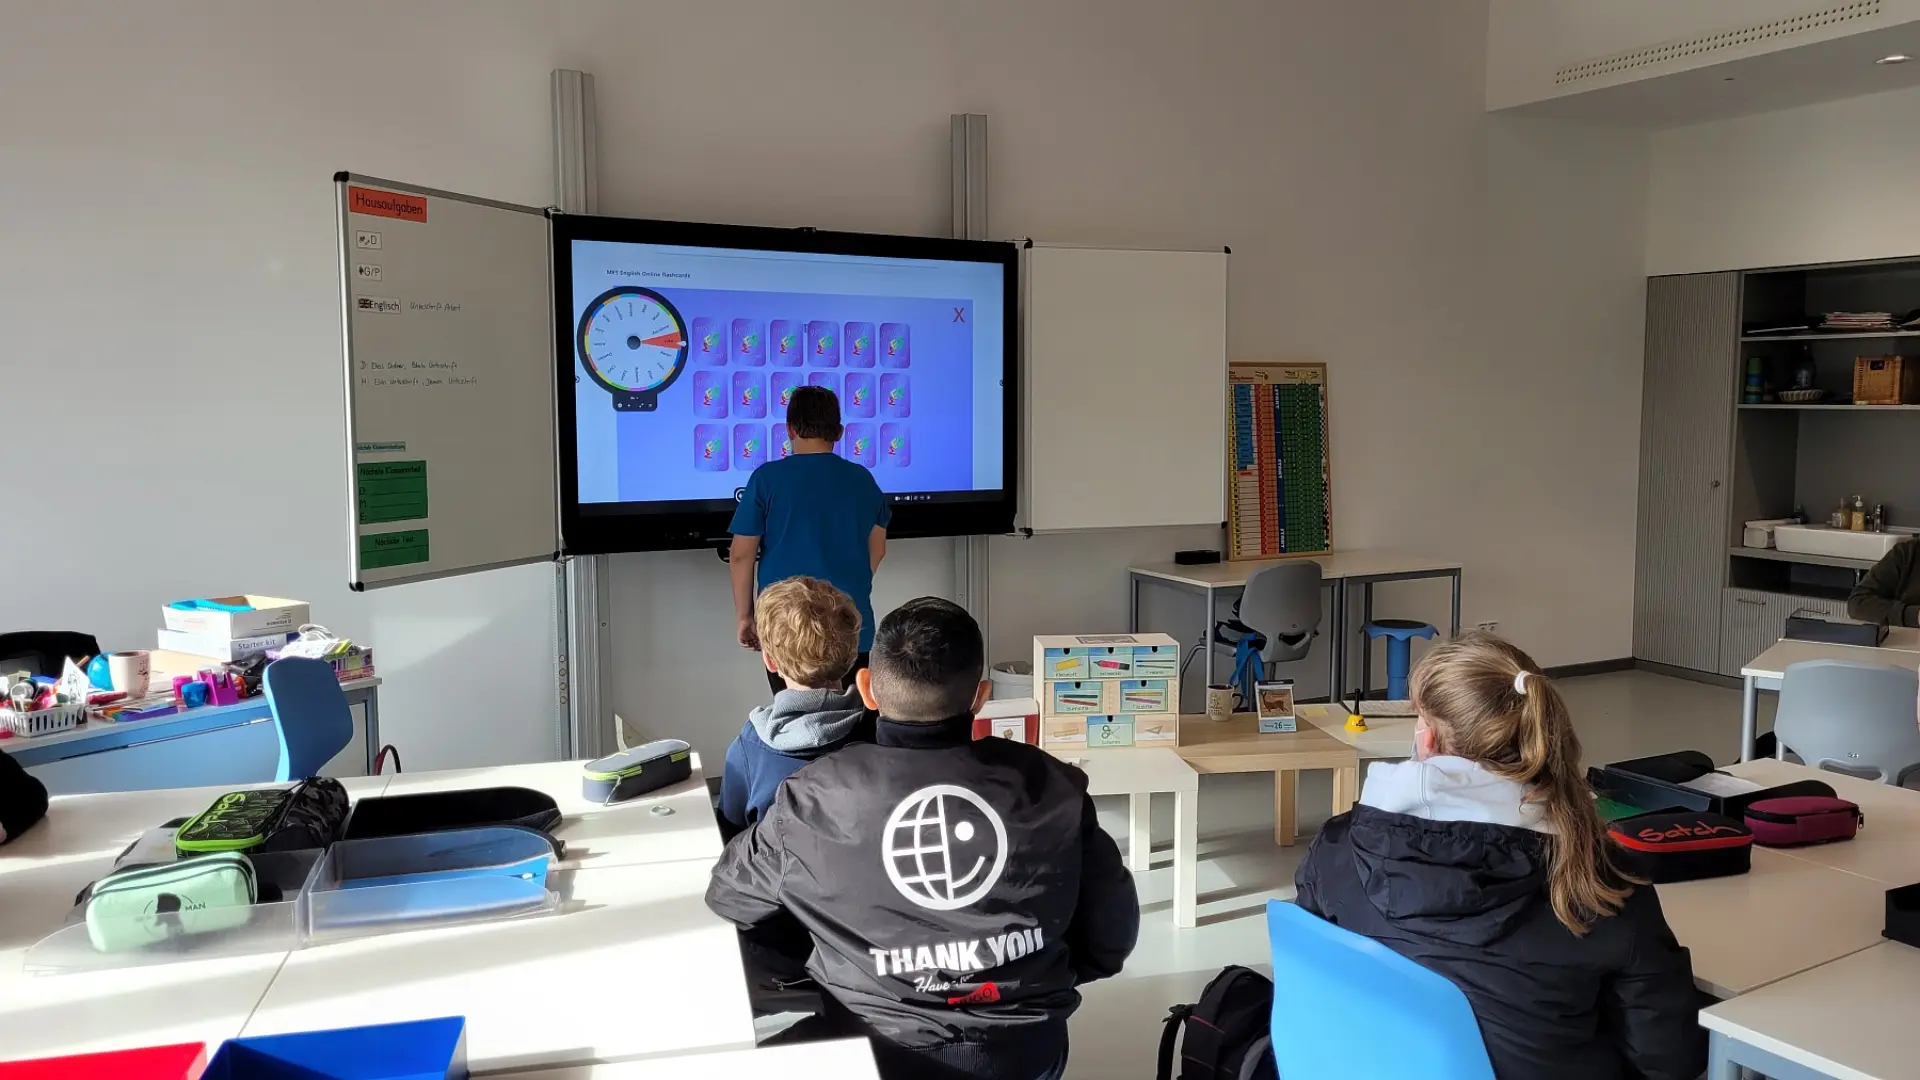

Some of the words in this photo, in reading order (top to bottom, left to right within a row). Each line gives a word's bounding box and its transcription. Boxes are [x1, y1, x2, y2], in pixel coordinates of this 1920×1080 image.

[355, 192, 423, 216] Hausaufgaben
[369, 300, 399, 311] Englisch
[781, 439, 792, 458] ME
[238, 641, 264, 650] Starter
[265, 638, 275, 646] kit
[185, 903, 206, 911] MAN
[869, 940, 984, 977] THANK
[986, 927, 1044, 967] YOU
[913, 975, 951, 993] Have
